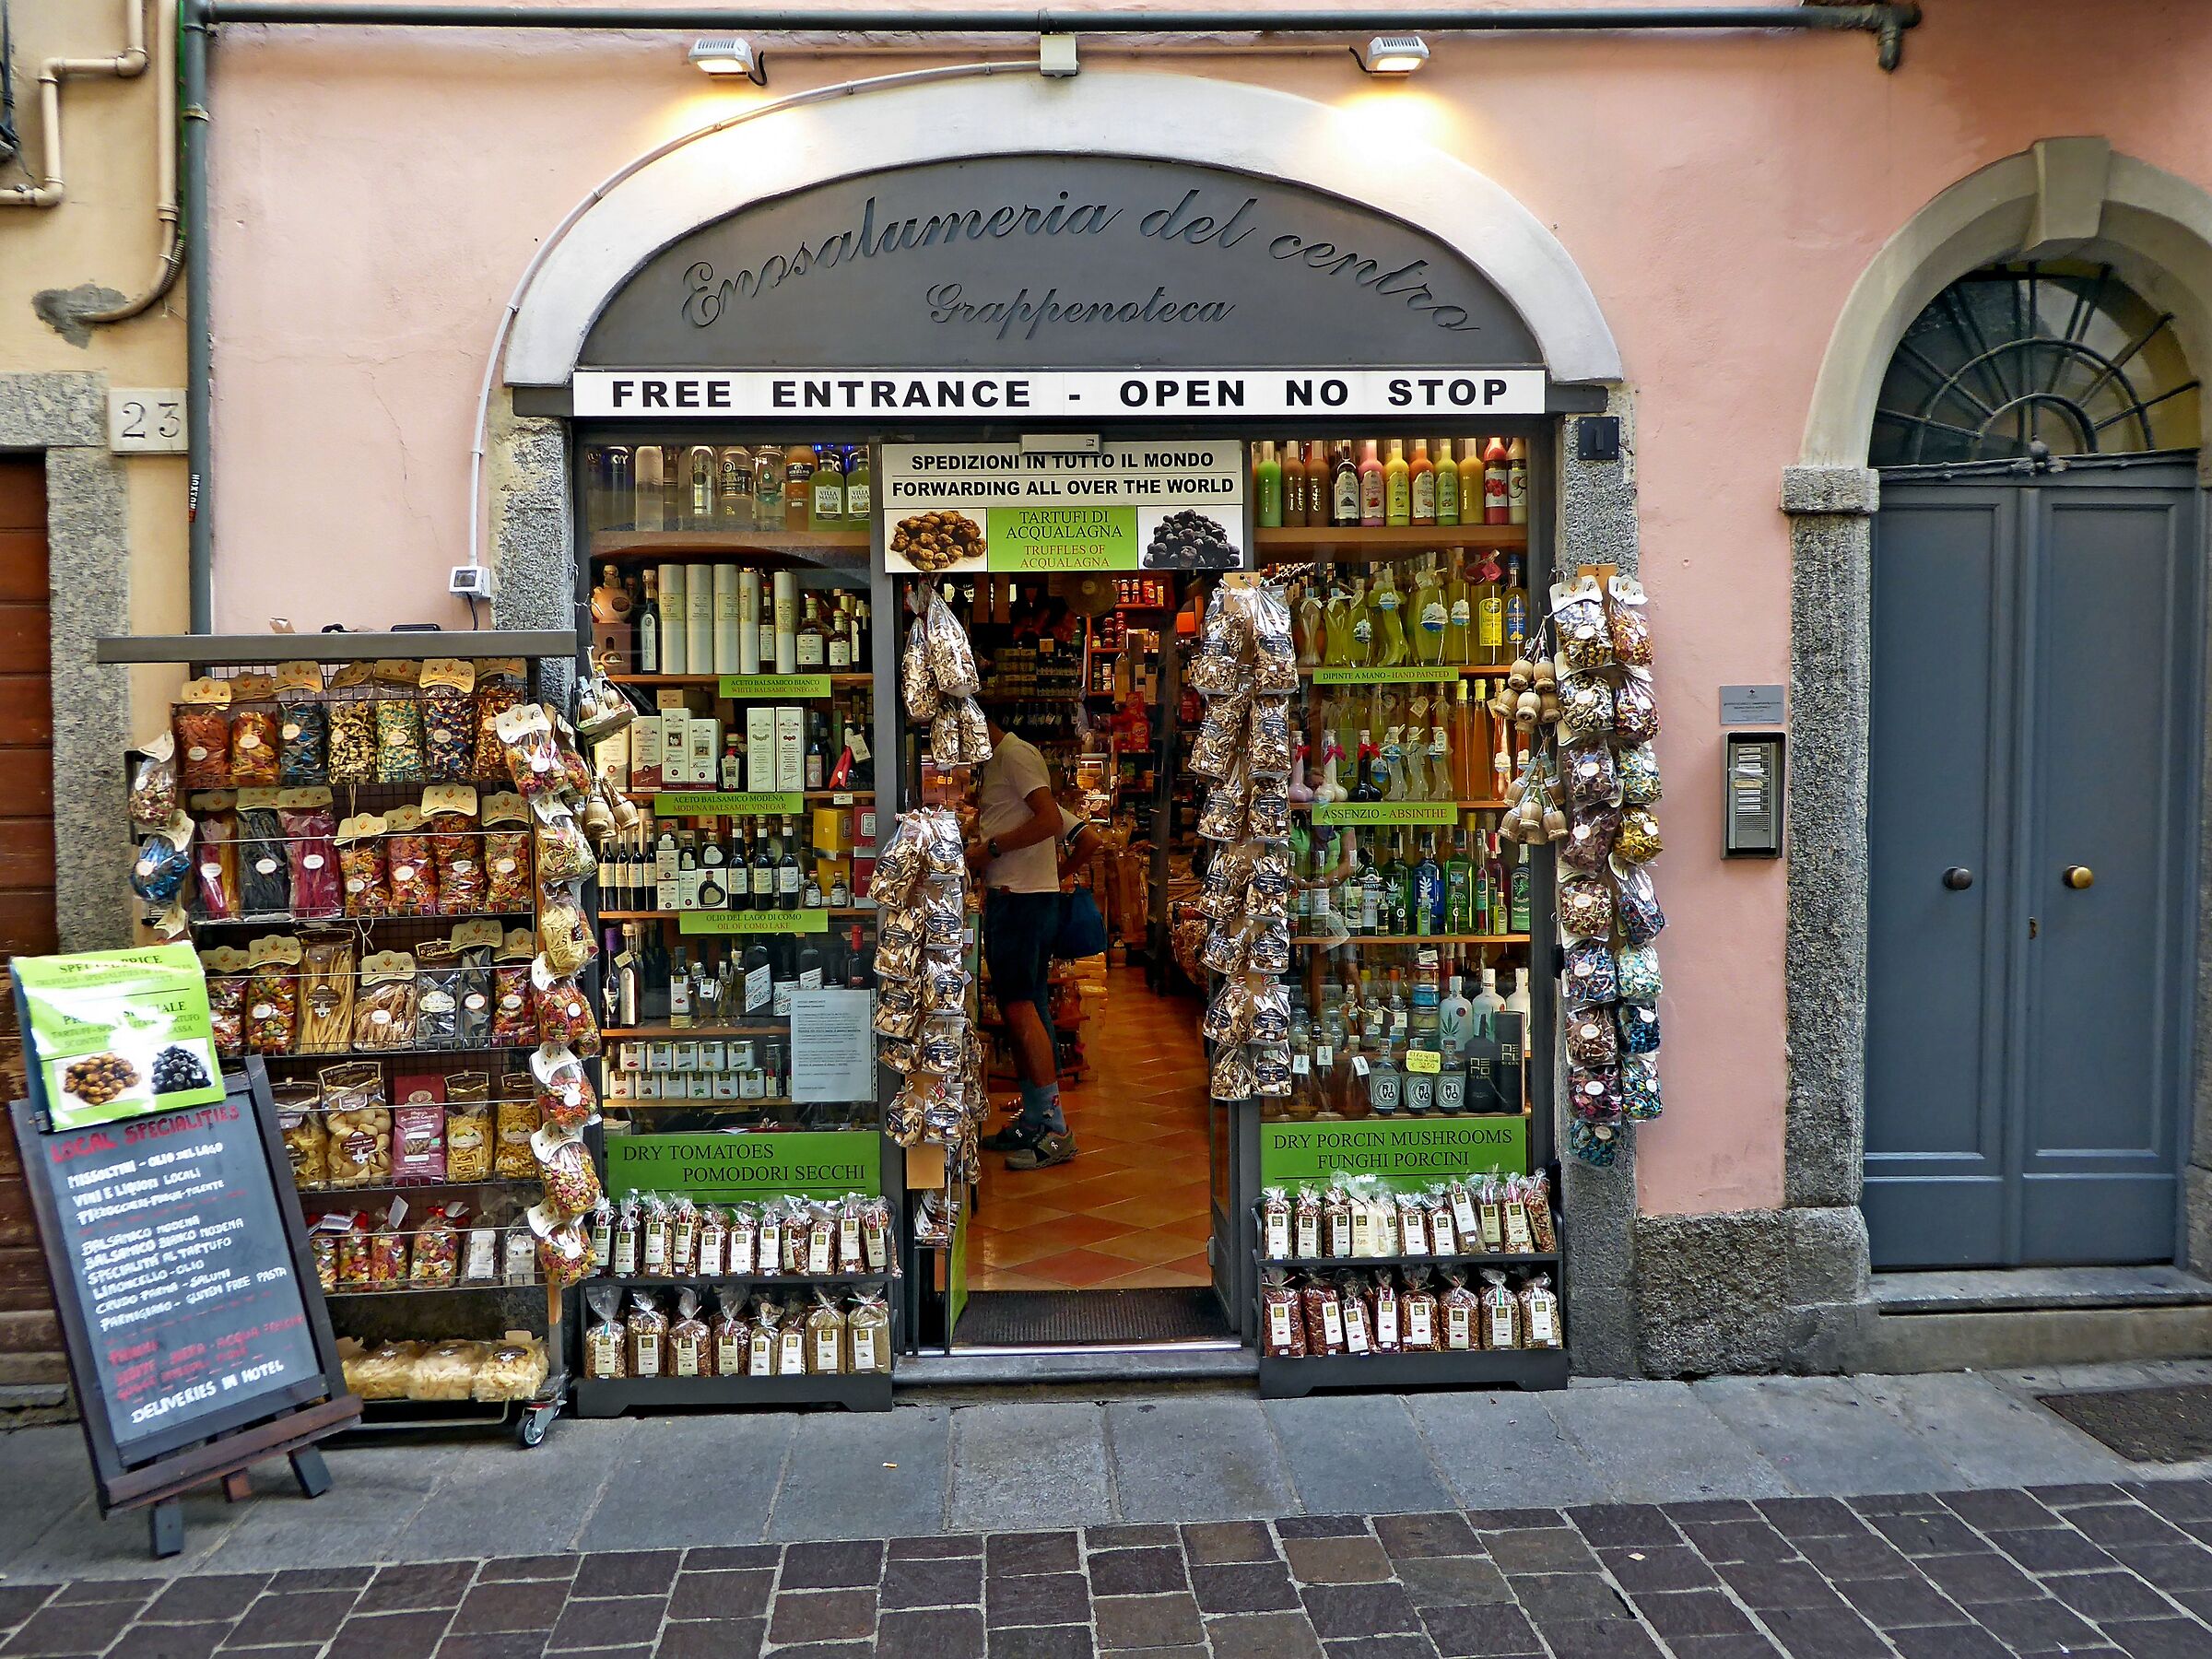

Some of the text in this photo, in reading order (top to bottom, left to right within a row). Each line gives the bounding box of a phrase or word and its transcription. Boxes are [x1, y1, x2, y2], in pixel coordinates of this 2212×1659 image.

[681, 189, 1481, 332] Enosalumeria del centro
[925, 283, 1236, 340] Grappenoteca
[613, 381, 731, 407] FREE
[773, 380, 1031, 407] ENTRANCE
[1120, 379, 1244, 407] OPEN
[1286, 379, 1348, 406] NO
[1388, 378, 1508, 406] STOP
[121, 401, 182, 440] 23
[912, 452, 1214, 470] SPEDIZIONI IN TUTTO IL MONDO
[892, 478, 1234, 497] FORWARDING ALL OVER THE WORLD
[1018, 511, 1108, 524] TARTUFI DI
[1006, 524, 1124, 540] ACQUALAGNA
[1024, 544, 1106, 556] TRUFFLES OF
[1020, 557, 1110, 569] ACQUALAGNA
[1323, 809, 1380, 819] ASSENZIO
[1389, 808, 1448, 818] ABSINTHE
[50, 1105, 240, 1163] LOCAL SPECIALITIES
[1274, 1128, 1512, 1149] DRY PORCIN MUSHROOMS
[195, 1141, 224, 1158] LAGO
[623, 1143, 774, 1161] DRY TOMATOES
[1317, 1150, 1469, 1170] FUNGHI PORCINI
[104, 1186, 114, 1199] E
[162, 1167, 202, 1185] LOCALI
[682, 1164, 865, 1182] POMODORI SECCHI
[81, 1215, 200, 1256] BALSAMICO MODENA
[82, 1218, 244, 1270] BALSAMICO BIANCO MODENA
[177, 1236, 232, 1260] TARTUFO
[185, 1284, 224, 1305] GLUTEN
[225, 1275, 252, 1293] FREE
[255, 1266, 288, 1283] PASTA
[95, 1294, 138, 1315] CRUDO
[131, 1381, 218, 1424] DELIVERIES
[221, 1373, 239, 1391] IN
[241, 1359, 284, 1383] HOTEL
